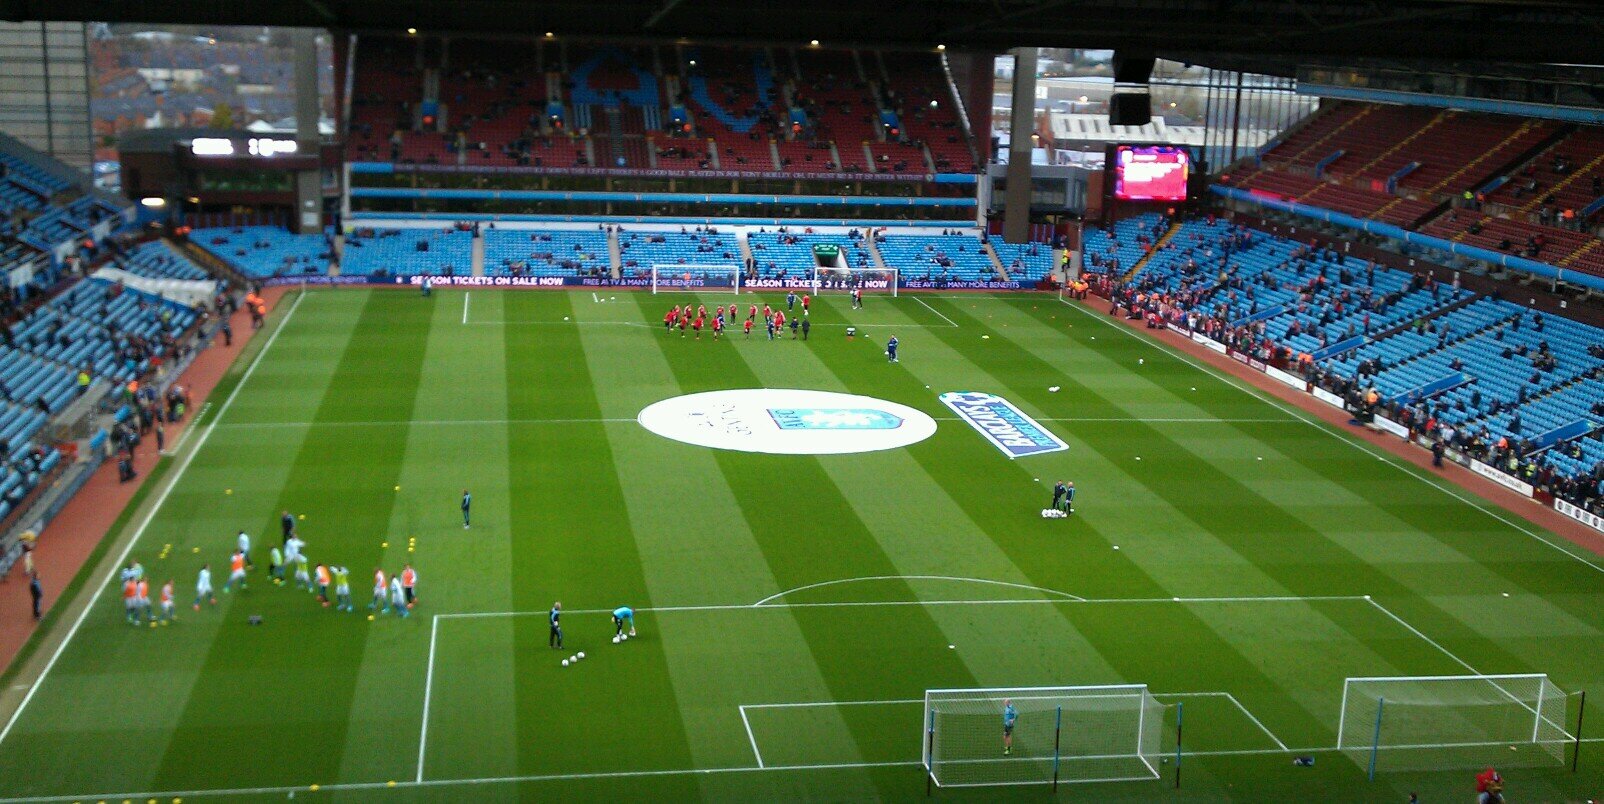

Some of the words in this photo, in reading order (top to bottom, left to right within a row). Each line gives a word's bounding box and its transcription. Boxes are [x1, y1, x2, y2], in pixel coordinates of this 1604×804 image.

[452, 276, 494, 285] TICKETS
[495, 276, 510, 285] ON
[512, 276, 537, 285] SALE
[539, 277, 564, 286] NOW
[627, 278, 648, 286] MANY
[650, 278, 669, 286] MORE
[745, 279, 782, 288] SEASON
[784, 279, 822, 288] TICKETS
[864, 280, 888, 288] NOW
[989, 281, 1020, 289] BENEFITS
[959, 405, 1037, 447] BARCLAYS
